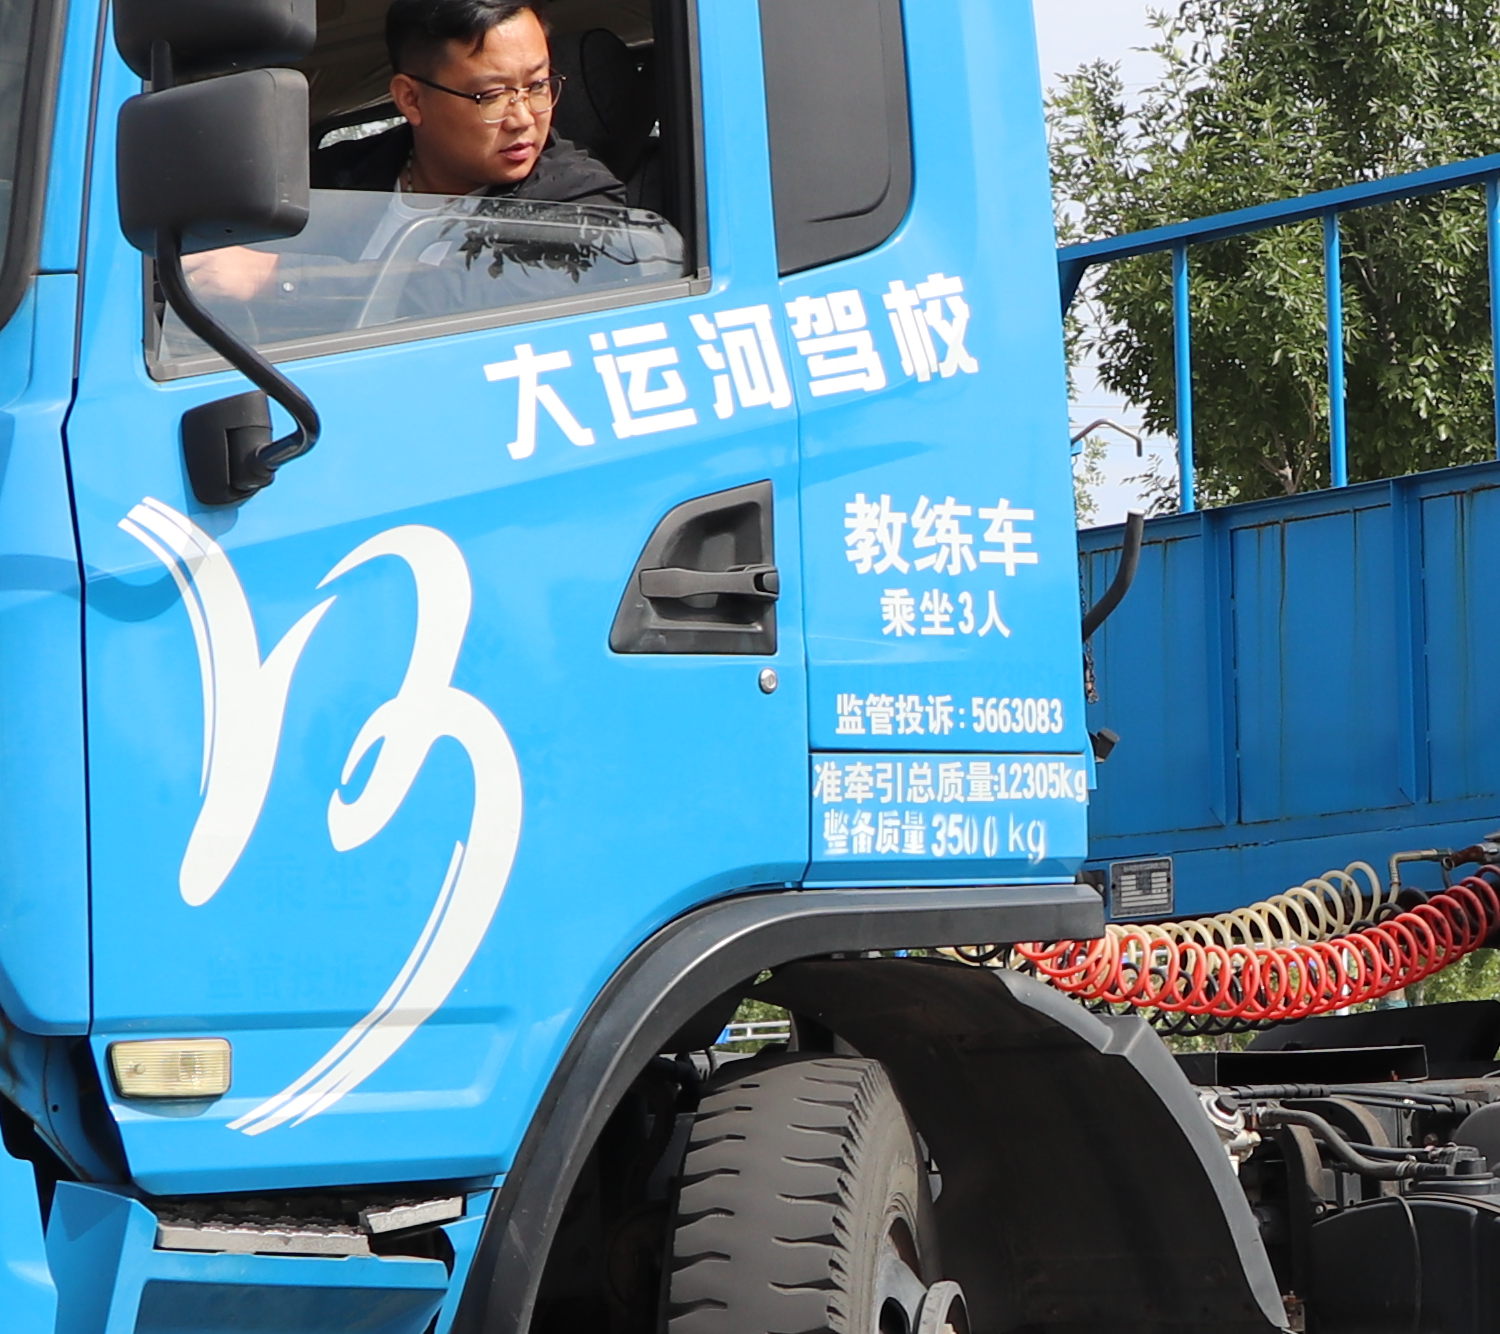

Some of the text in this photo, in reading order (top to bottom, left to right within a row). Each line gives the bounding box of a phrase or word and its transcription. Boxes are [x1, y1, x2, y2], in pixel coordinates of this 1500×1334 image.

[482, 272, 979, 461] 大运河驾校
[843, 493, 1039, 578] 教练车
[879, 588, 1012, 639] 乘坐3人
